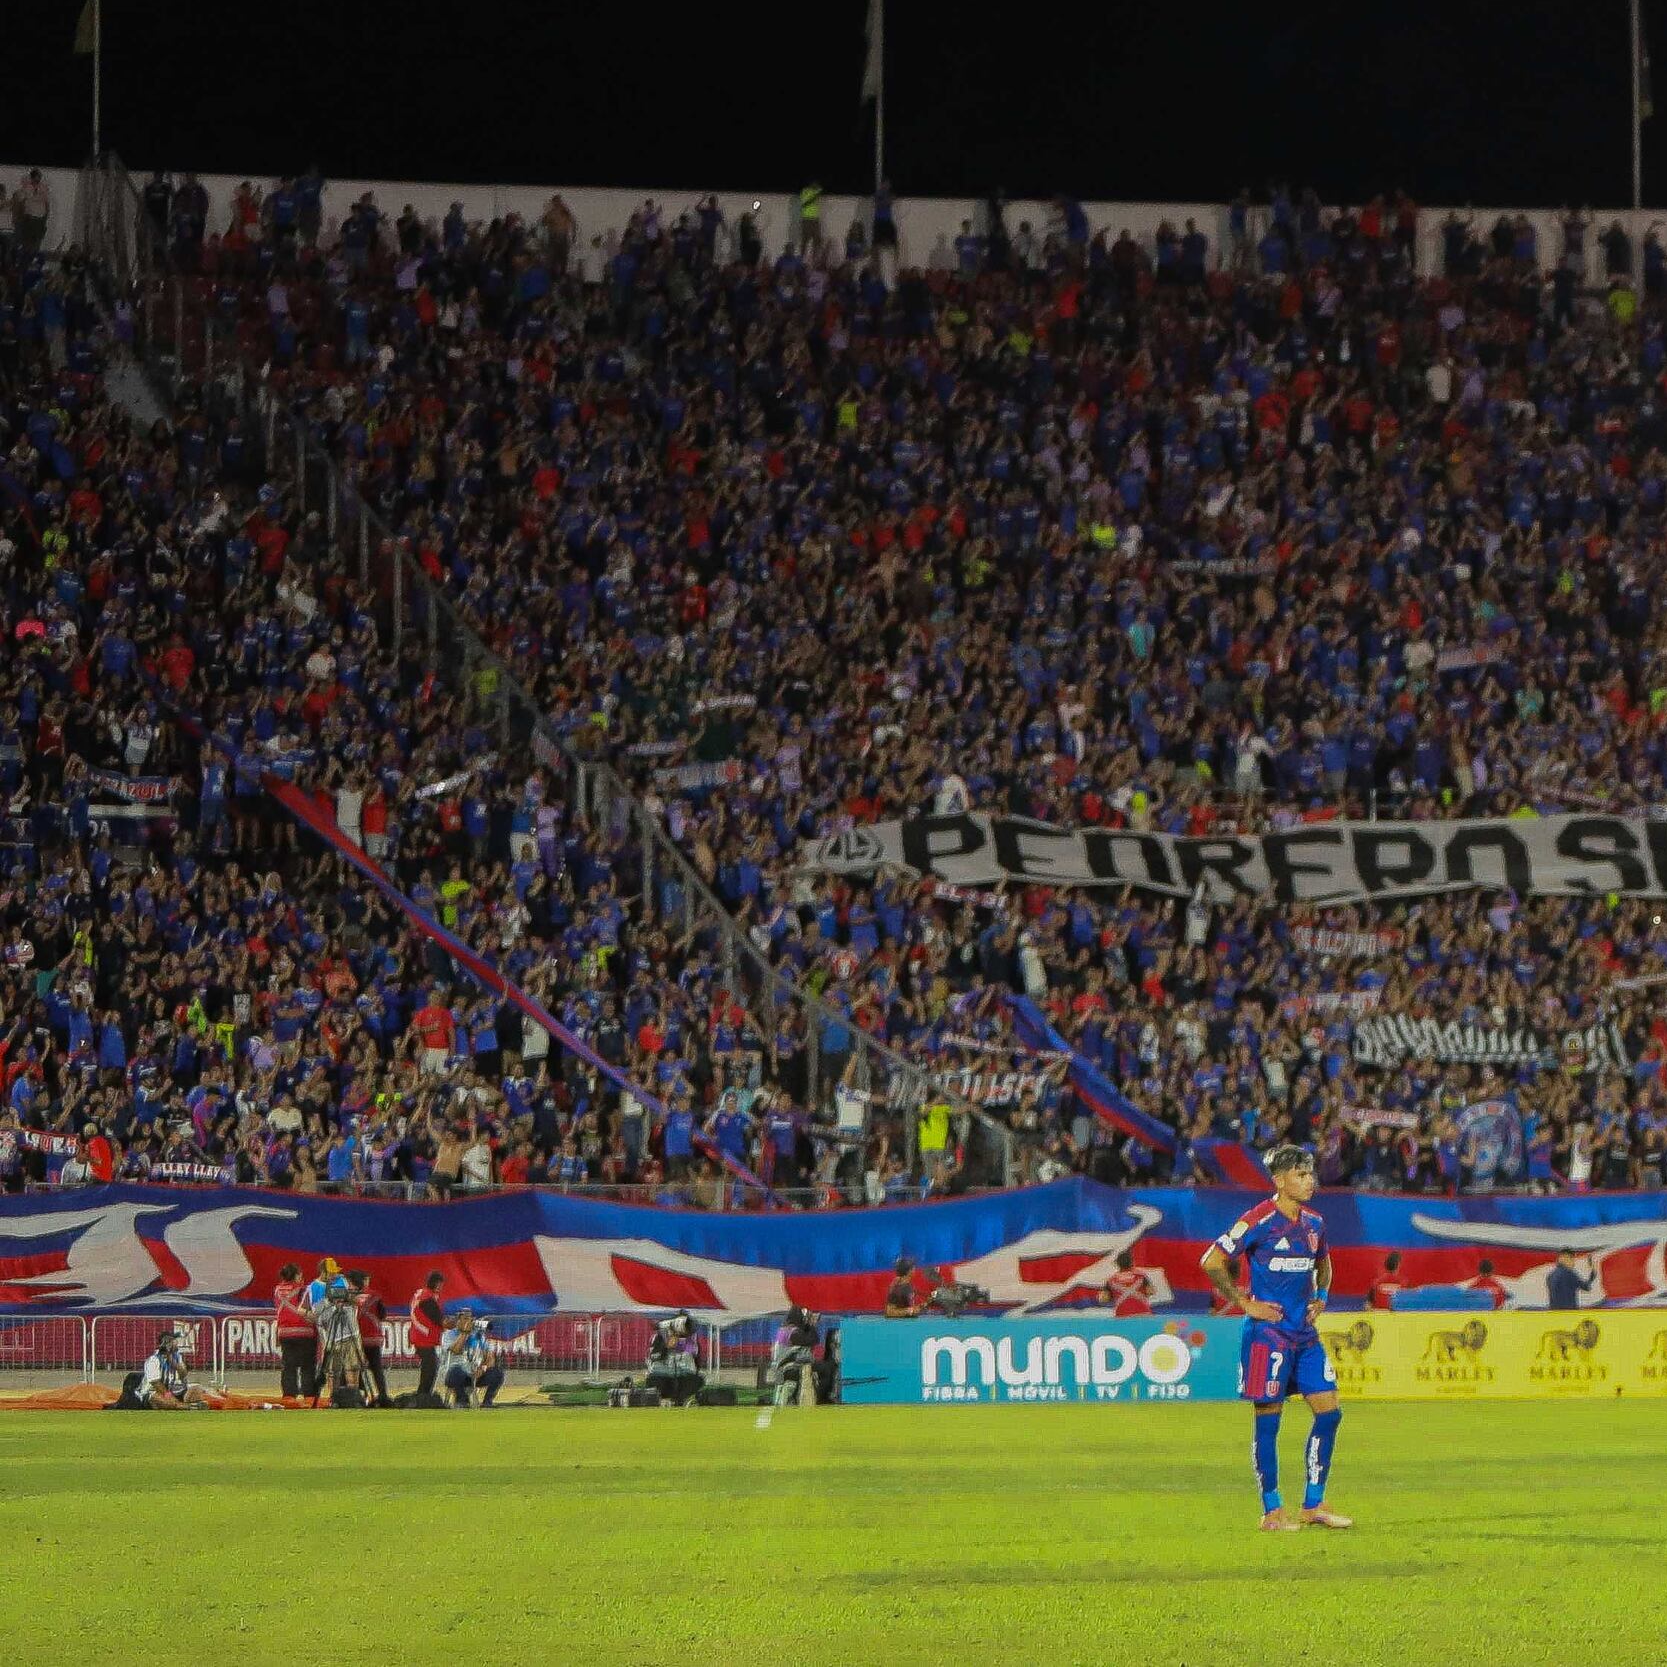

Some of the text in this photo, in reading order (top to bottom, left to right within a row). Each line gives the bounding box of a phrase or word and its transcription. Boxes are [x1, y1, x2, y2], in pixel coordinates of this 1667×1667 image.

[1416, 1366, 1496, 1381] MARLEY
[1530, 1365, 1608, 1381] MARLEY
[922, 1386, 979, 1401] FIBRA
[1096, 1386, 1120, 1401] TV
[1149, 1385, 1190, 1401] FIJO
